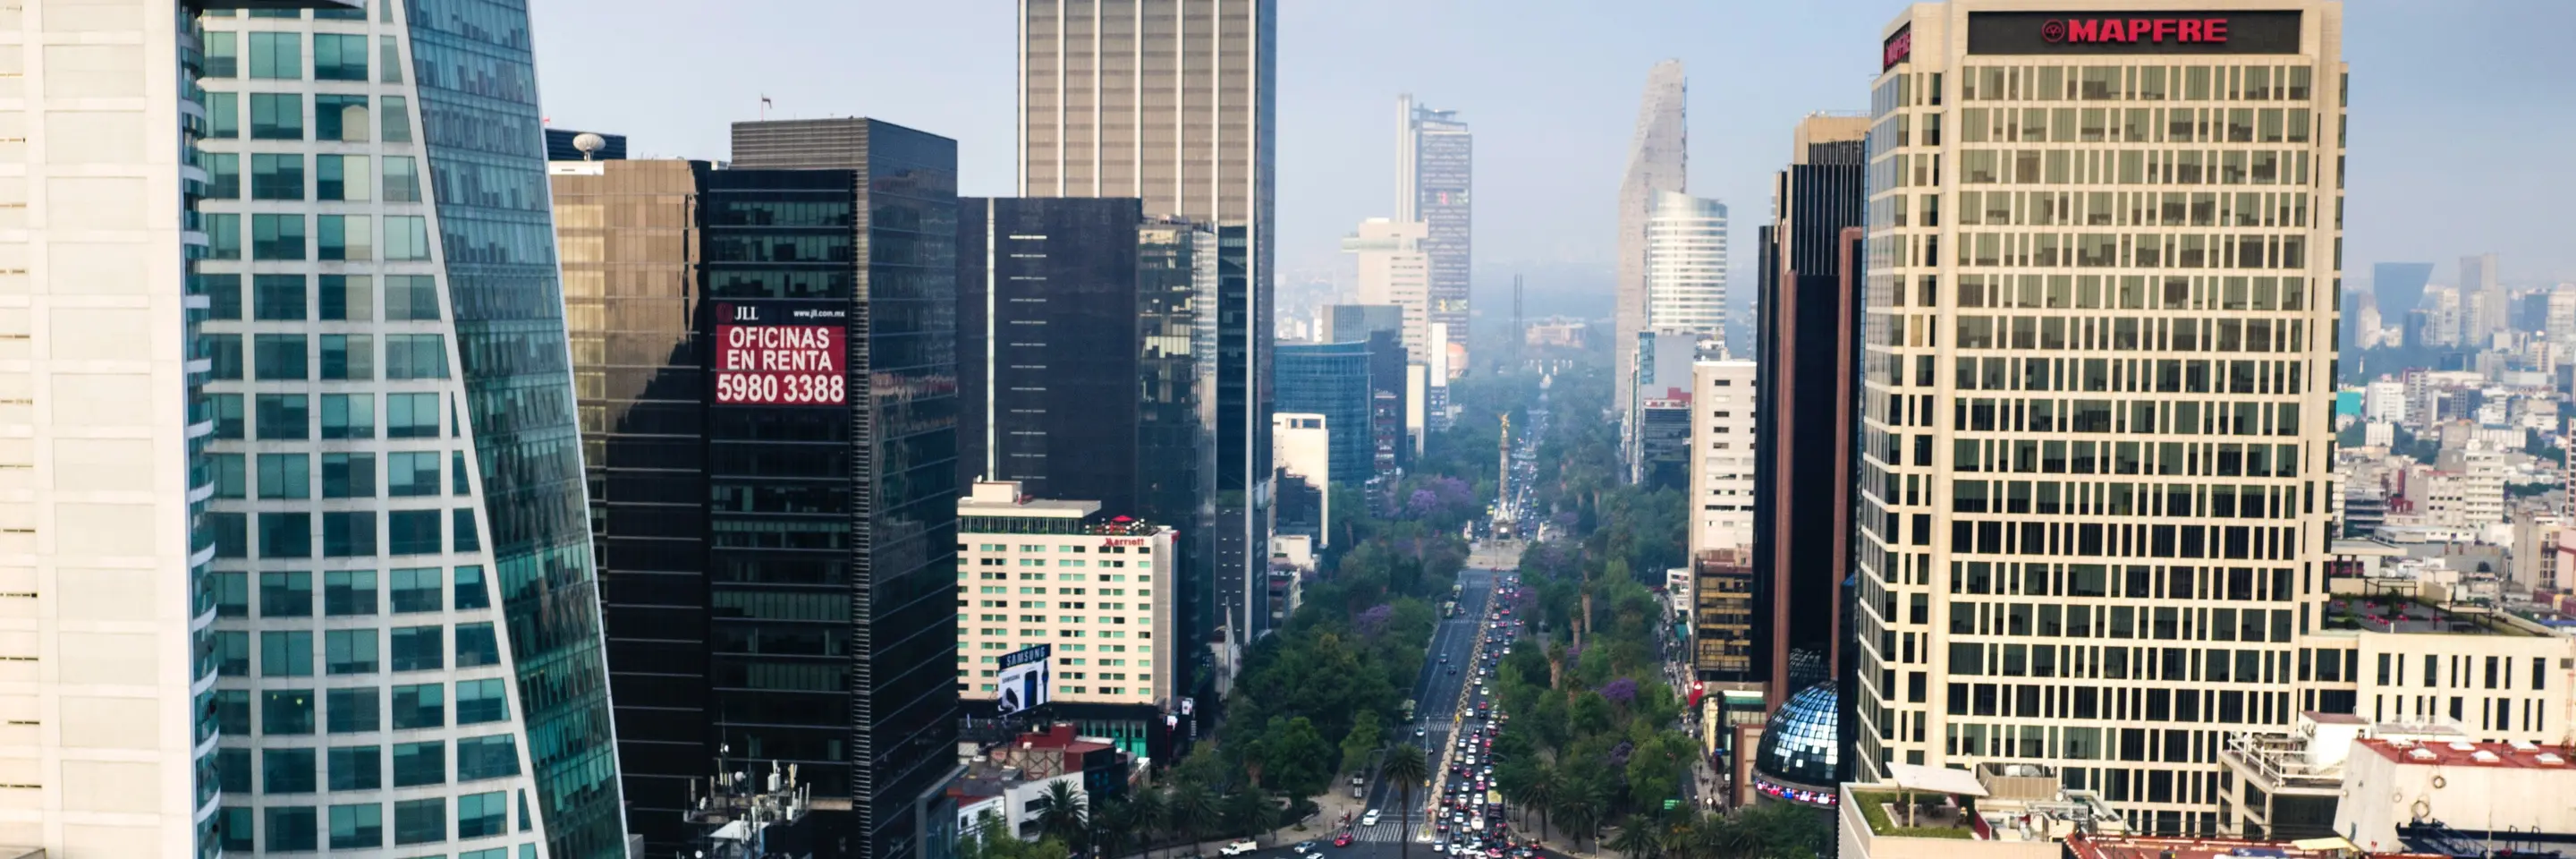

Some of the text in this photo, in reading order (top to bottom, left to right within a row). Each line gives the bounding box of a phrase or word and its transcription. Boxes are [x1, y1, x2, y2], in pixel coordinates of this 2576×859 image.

[2068, 18, 2228, 42] MAPFRE
[734, 306, 758, 320] JLL
[729, 327, 830, 349] OFICINAS
[727, 349, 833, 371] EN RENTA
[717, 373, 844, 403] 5980 3388
[1103, 538, 1145, 547] Marriott
[1006, 647, 1046, 667] SAMSUNG
